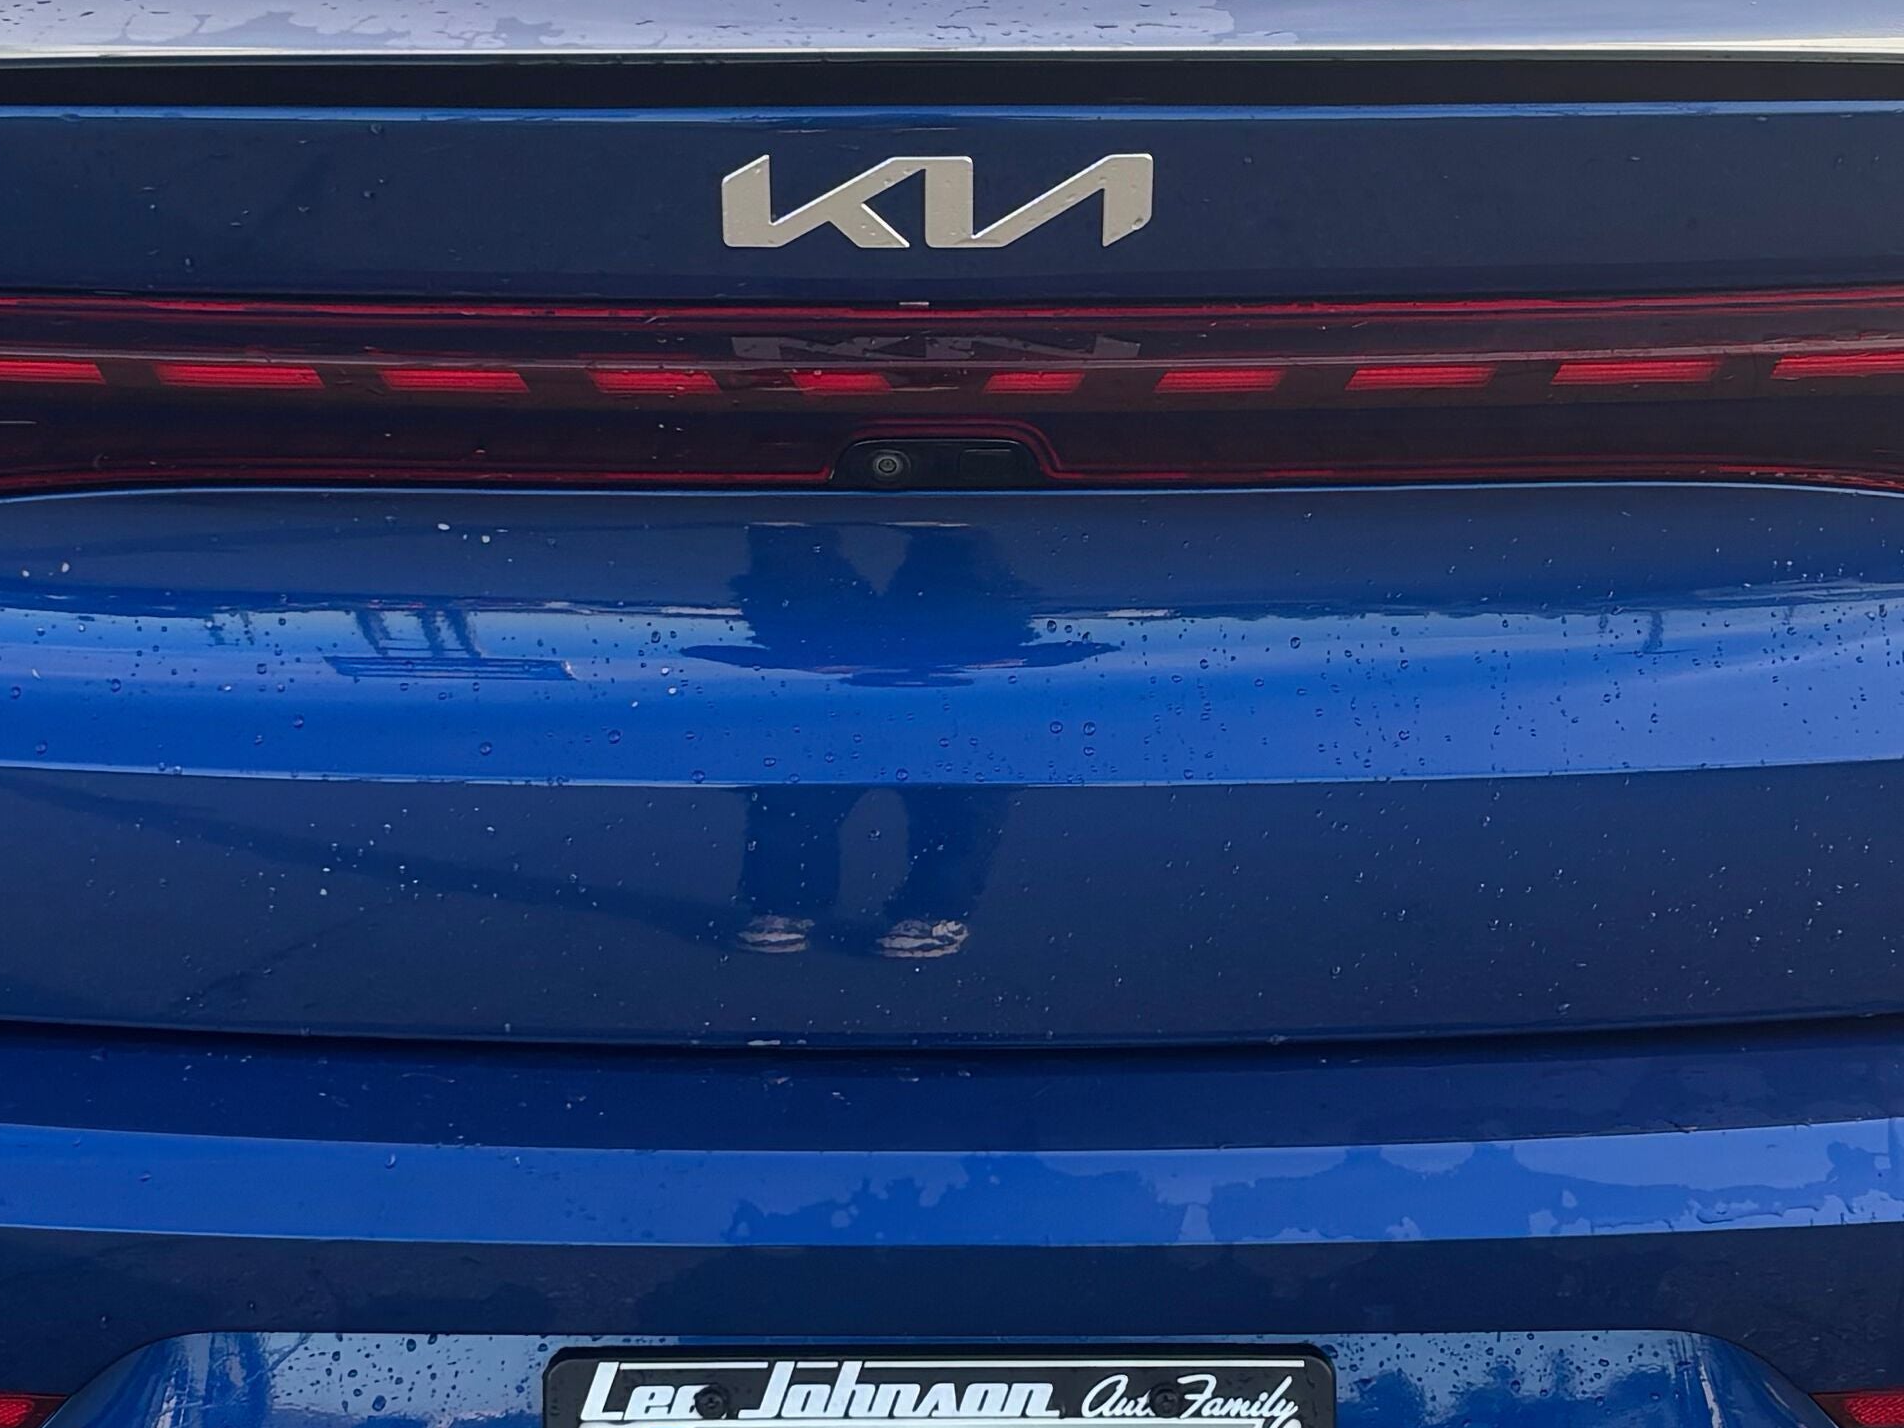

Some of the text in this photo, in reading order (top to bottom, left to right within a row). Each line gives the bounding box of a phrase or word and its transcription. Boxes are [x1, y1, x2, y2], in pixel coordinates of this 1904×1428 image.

[722, 153, 1153, 248] KIA
[737, 1361, 1060, 1420] Johnson
[1081, 1374, 1157, 1418] Aut
